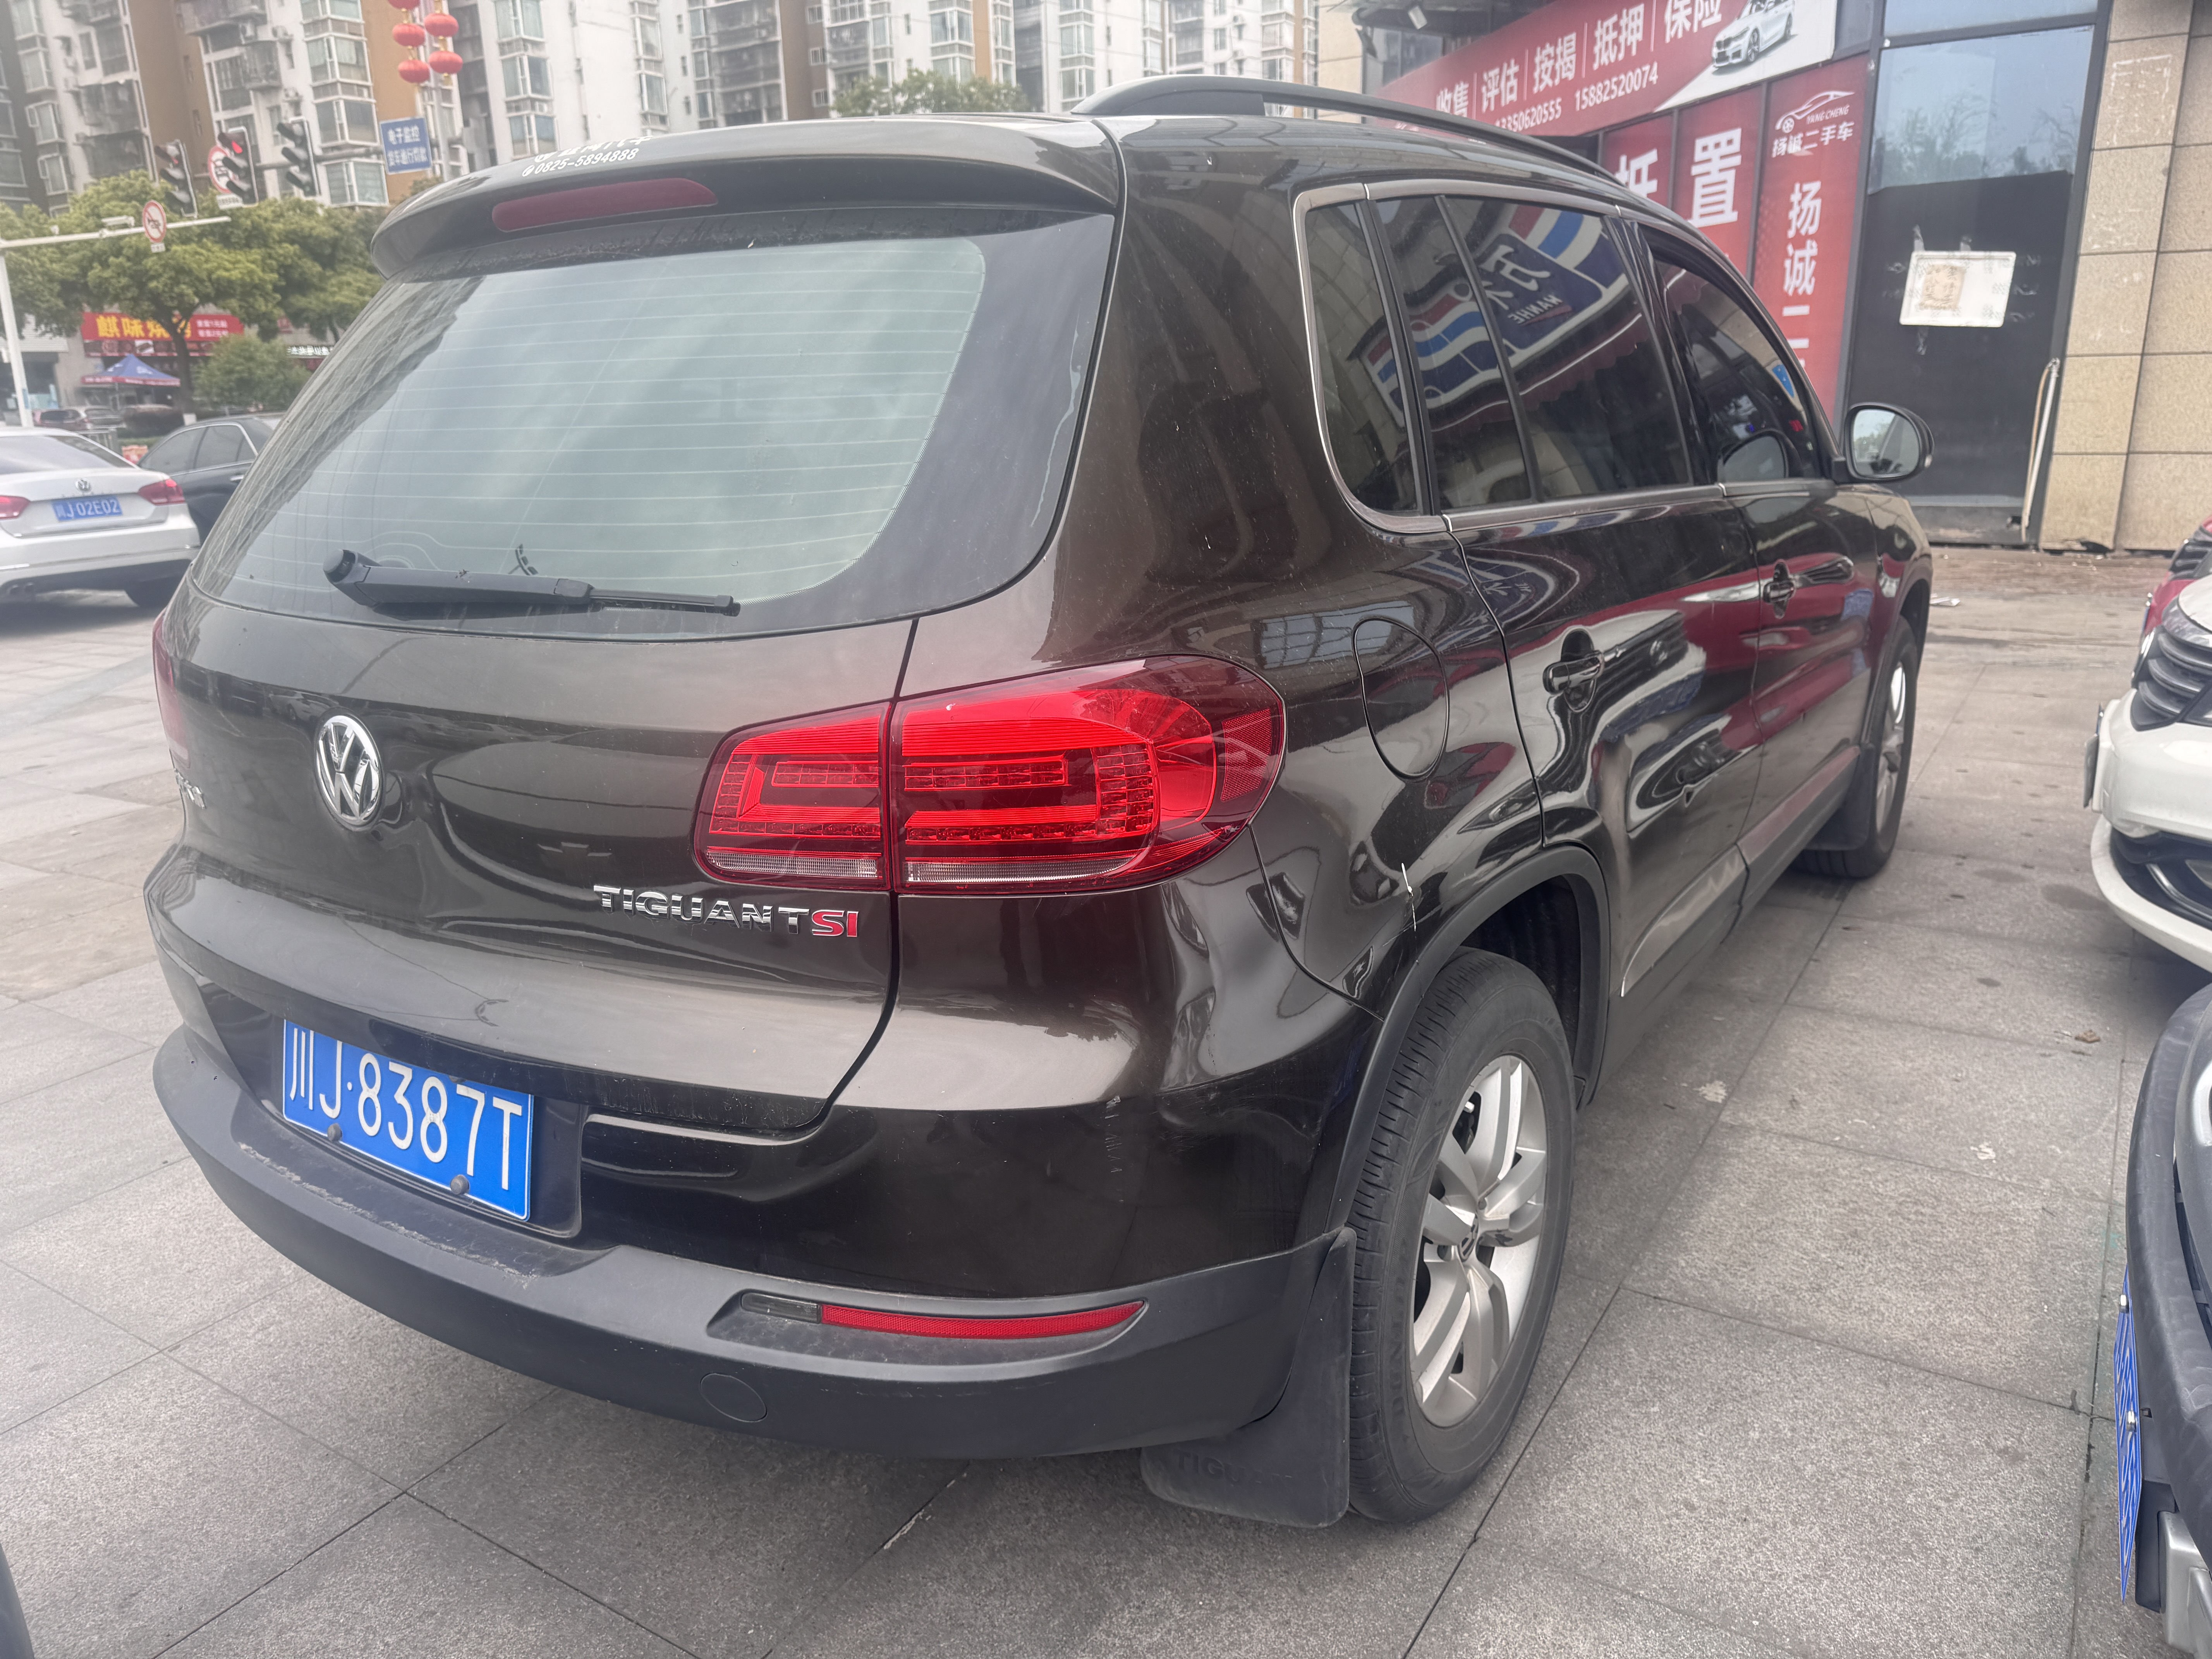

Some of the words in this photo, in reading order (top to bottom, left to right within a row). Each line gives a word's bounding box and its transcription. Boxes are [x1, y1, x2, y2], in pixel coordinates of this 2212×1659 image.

[1481, 58, 1520, 113] 评估
[1532, 32, 1576, 94] 按揭
[1593, 4, 1645, 70] 抵押
[1665, 0, 1722, 43] 保险
[1575, 61, 1658, 112] 15882520074
[1806, 111, 1825, 124] YANG
[1826, 104, 1850, 120] CHENG
[534, 148, 639, 174] 0825-5894888
[1783, 180, 1822, 368] 扬诚二
[594, 885, 773, 932] TIGUAN
